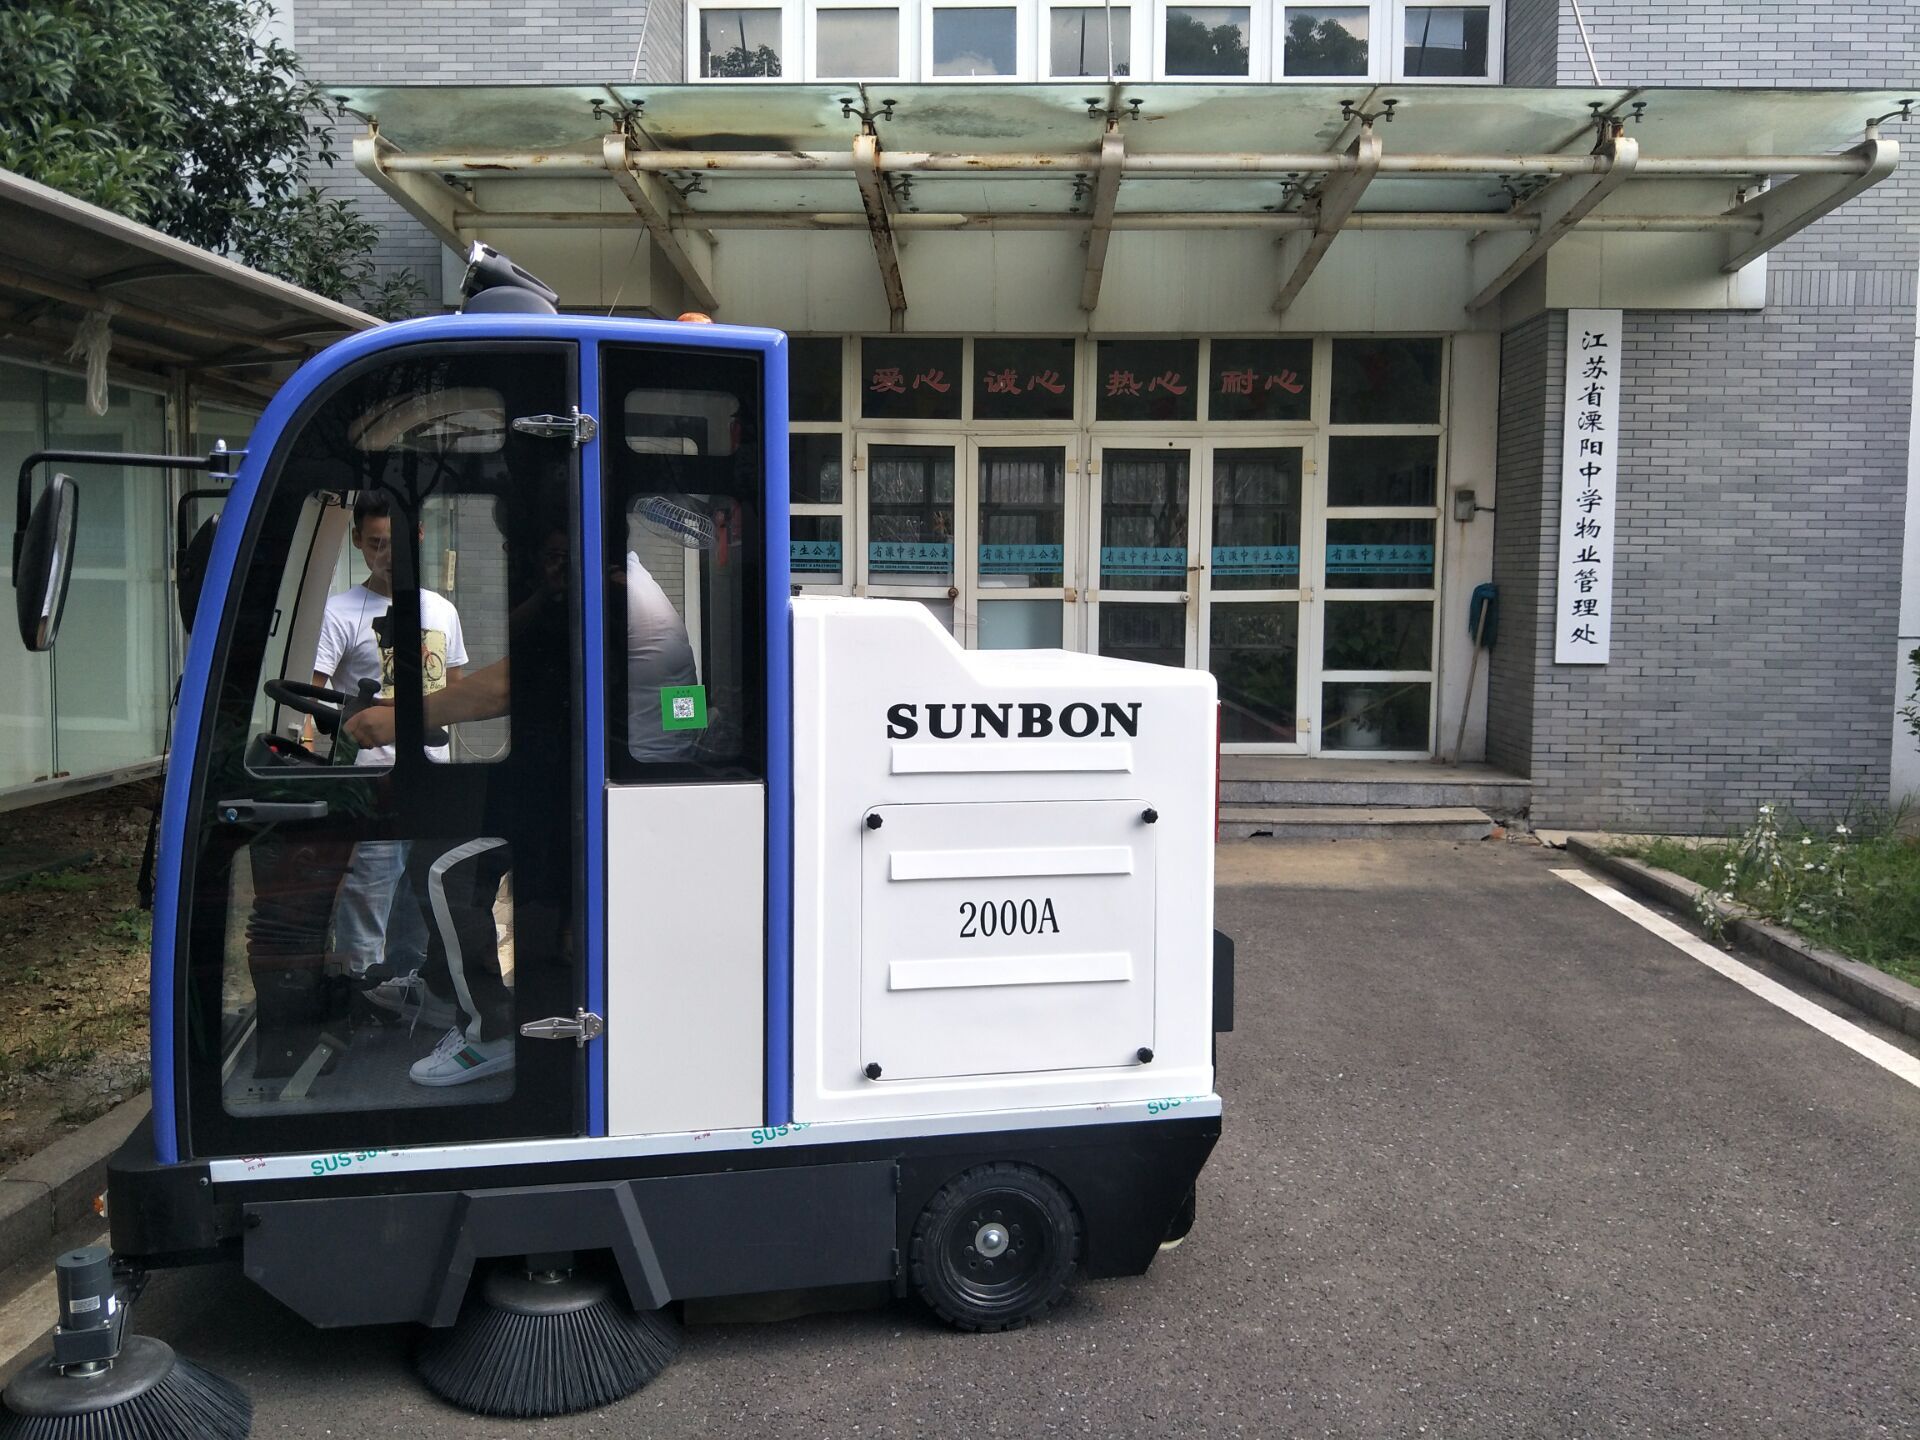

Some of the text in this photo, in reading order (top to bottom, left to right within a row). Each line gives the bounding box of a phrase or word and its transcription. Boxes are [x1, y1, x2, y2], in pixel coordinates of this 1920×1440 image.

[869, 368, 1305, 397] 爱心 诚心 热心 耐心
[1569, 330, 1609, 645] 江苏省溧阳中学物业管理处
[886, 702, 1142, 739] SUNBON
[959, 897, 1060, 938] 2000A
[751, 1124, 789, 1145] SUS
[310, 1151, 352, 1176] SUS
